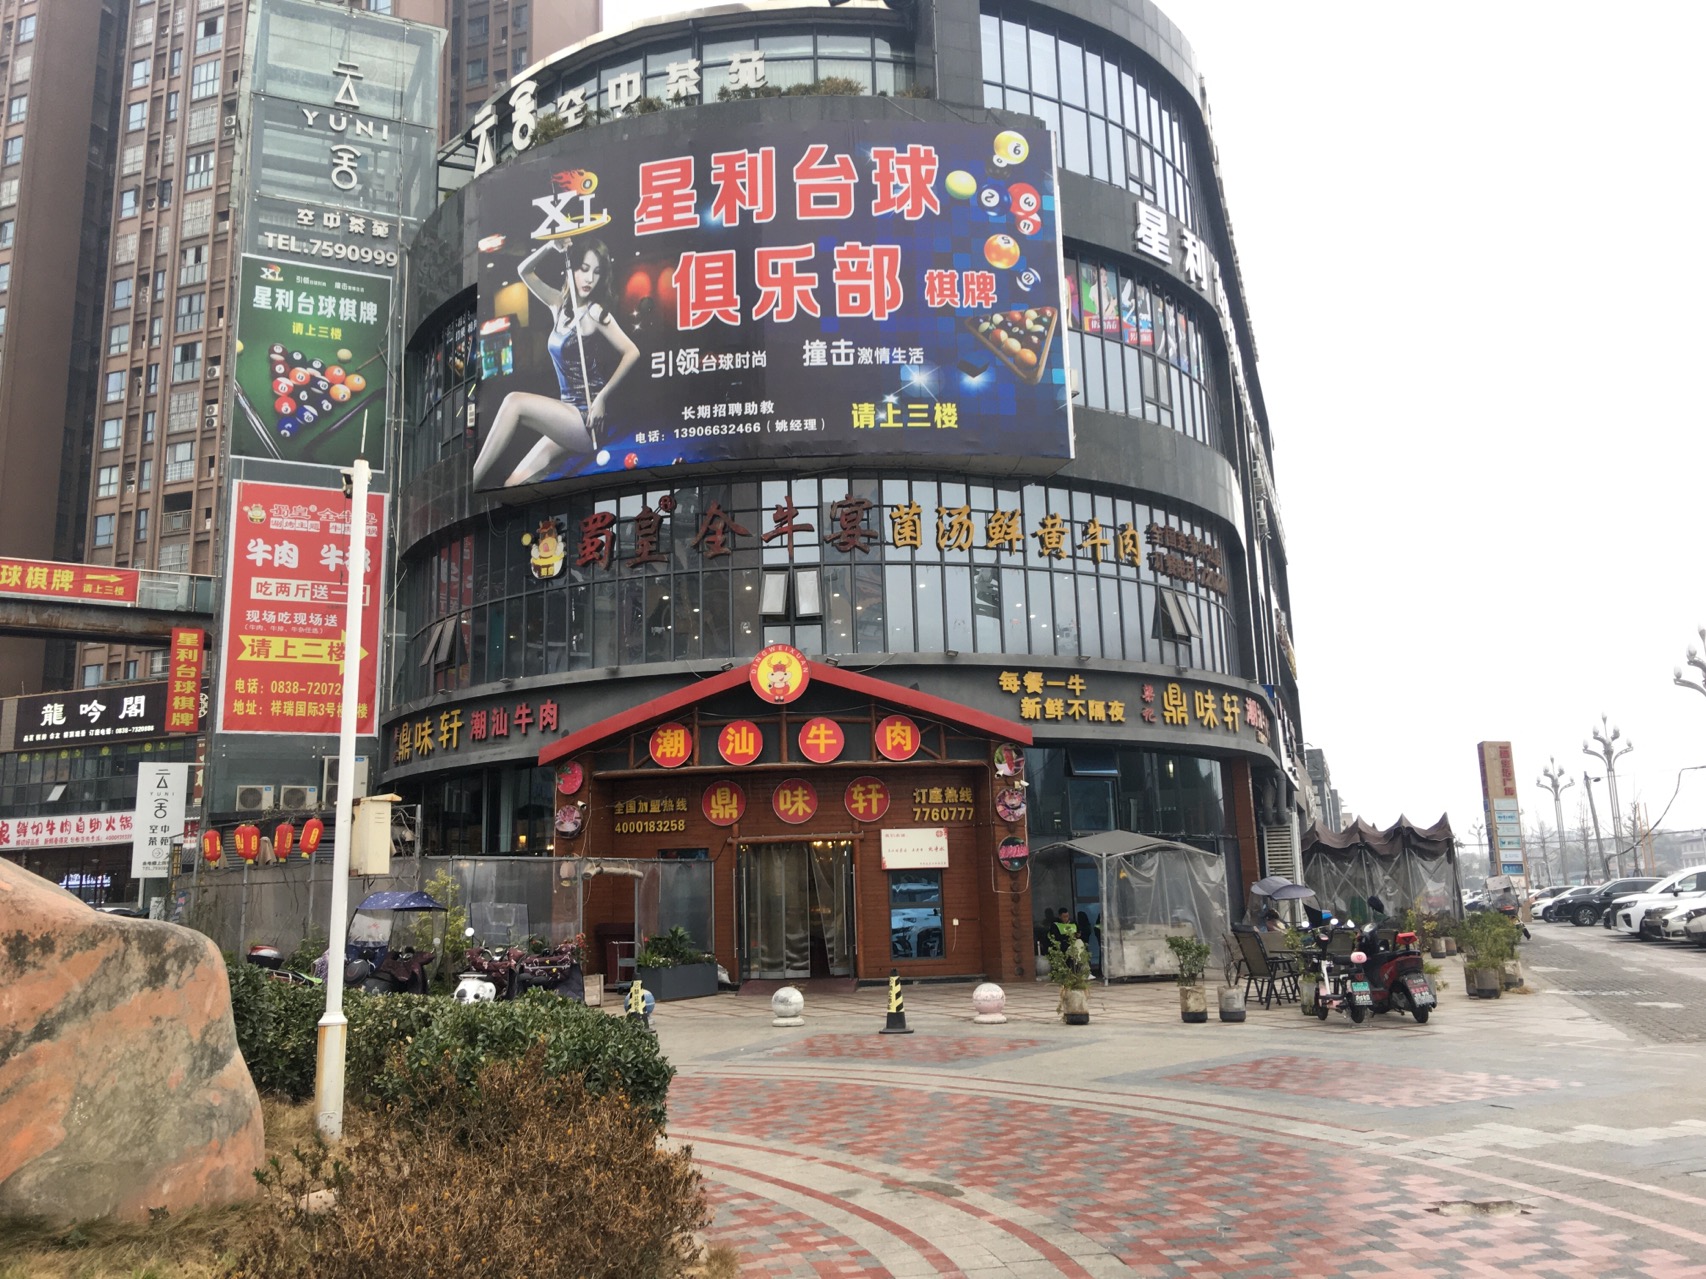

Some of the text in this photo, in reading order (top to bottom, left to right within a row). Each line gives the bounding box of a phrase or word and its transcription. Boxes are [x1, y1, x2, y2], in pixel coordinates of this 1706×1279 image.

[302, 108, 388, 141] YUNI
[634, 144, 940, 236] 星利台球
[297, 208, 389, 239] 空中茶苑
[531, 190, 607, 239] XL
[264, 232, 398, 268] TEL:7590999
[673, 241, 904, 331] 俱乐部
[925, 270, 997, 309] 棋牌
[252, 285, 378, 326] 星利台球棋牌
[651, 348, 767, 379] 引领台球时尚
[802, 338, 925, 367] 撞击激情生活
[682, 400, 775, 421] 长期招聘助教
[851, 402, 959, 430] 请上三楼
[890, 500, 1142, 568] 菌汤鲜黄牛肉
[246, 538, 299, 569] 牛肉
[256, 581, 364, 600] 吃两斤送一
[246, 610, 338, 627] 现场吃现场送
[751, 645, 808, 673] DINGWEIXUAN
[171, 632, 199, 727] 星利台球棋牌
[999, 671, 1087, 696] 每餐一牛
[40, 695, 146, 727] 龍吟閣
[470, 699, 558, 740] 潮汕牛肉
[1020, 697, 1126, 723] 新鲜不隔夜
[1163, 683, 1241, 732] 鼎味轩
[398, 709, 464, 762] 鼎味轩
[614, 797, 688, 815] 全国加盟热线
[913, 787, 973, 804] 订座热线
[17, 814, 133, 838] 鲜切牛肉自助火锅
[615, 819, 685, 834] 4000183258
[912, 807, 974, 822] 7760777
